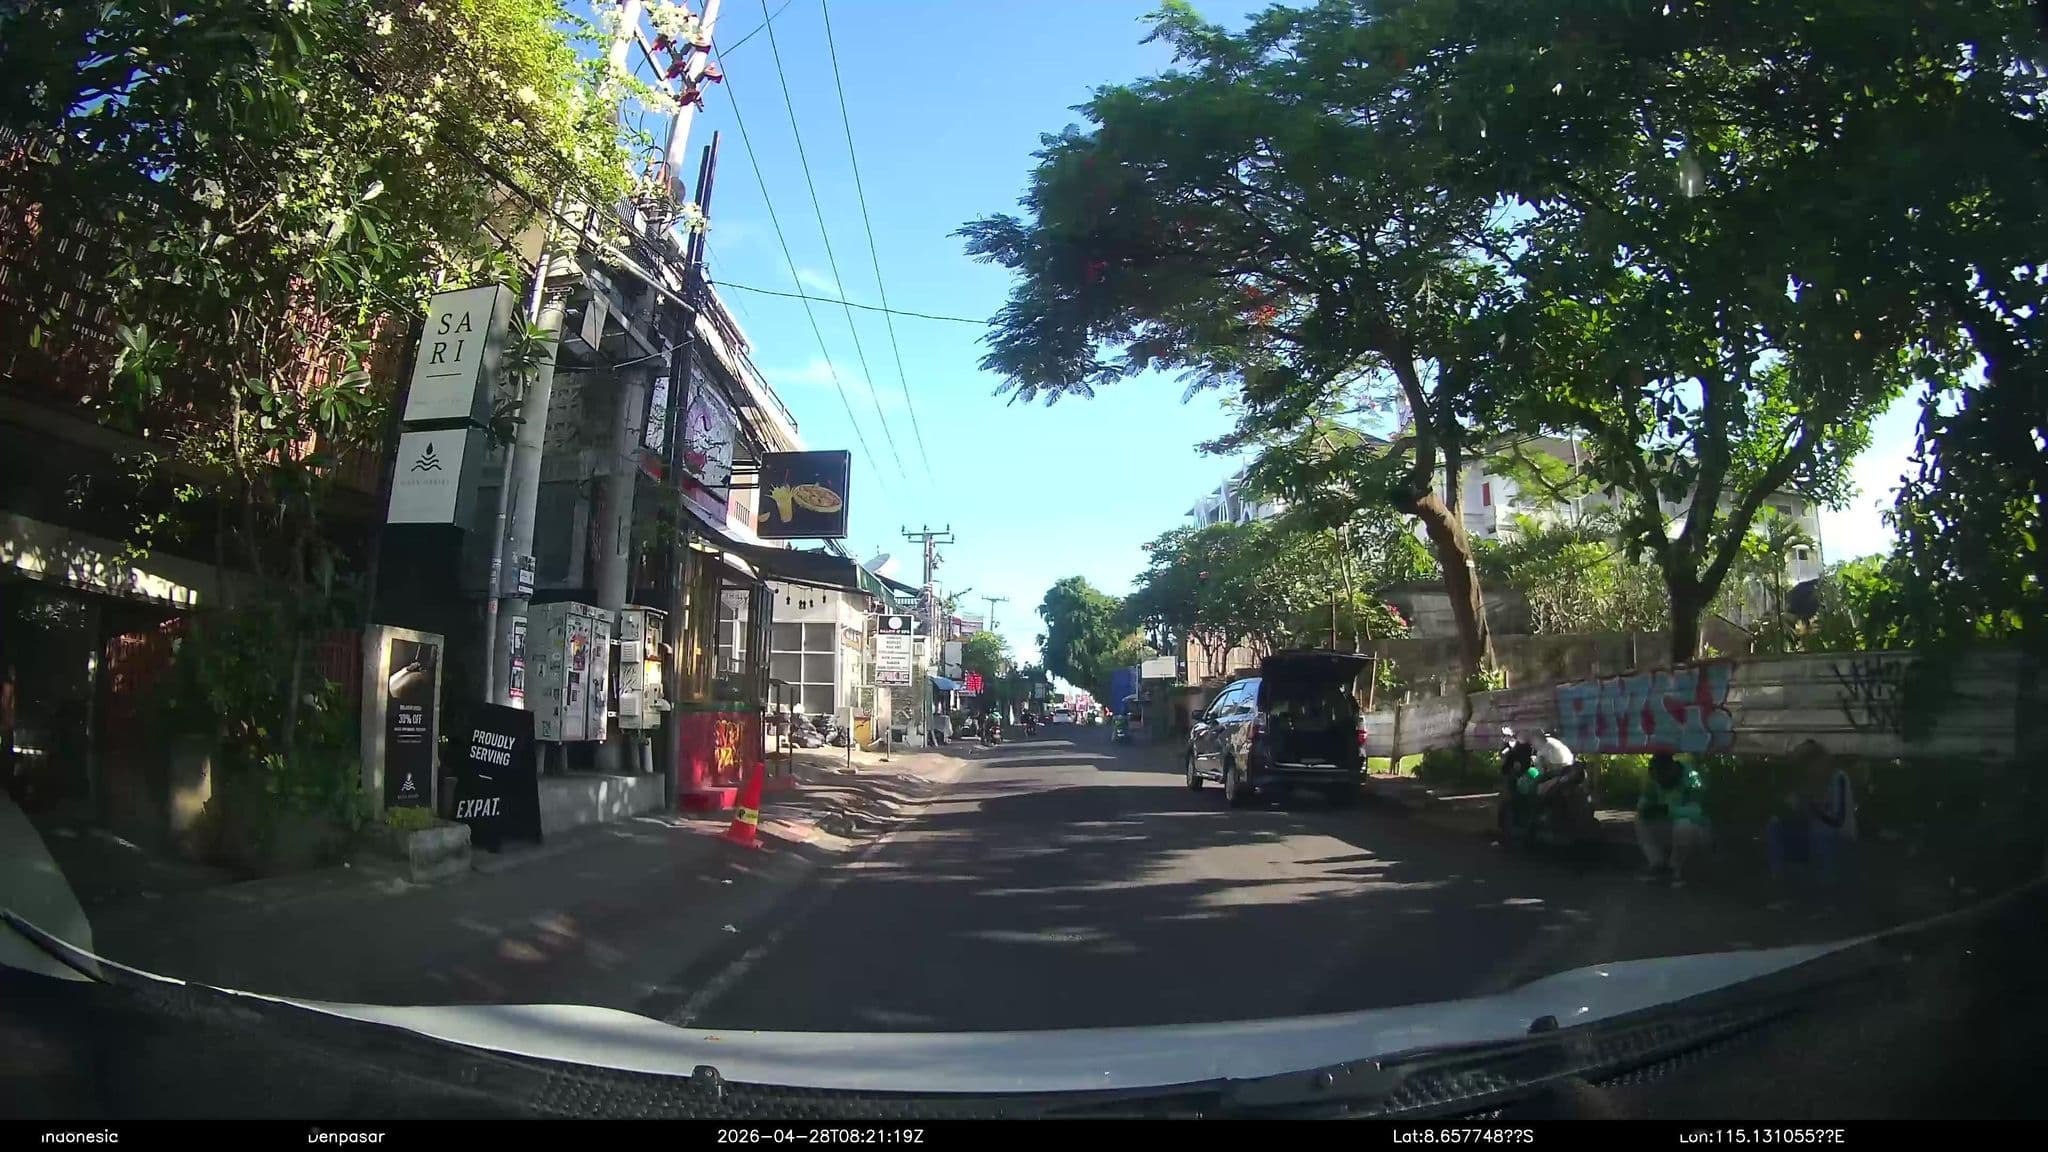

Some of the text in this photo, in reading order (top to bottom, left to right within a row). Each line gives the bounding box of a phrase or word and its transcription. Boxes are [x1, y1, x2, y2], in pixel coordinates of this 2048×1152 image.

[472, 729, 516, 750] PROUDLY
[469, 745, 511, 766] SERVING
[456, 797, 500, 818] EXPAT.
